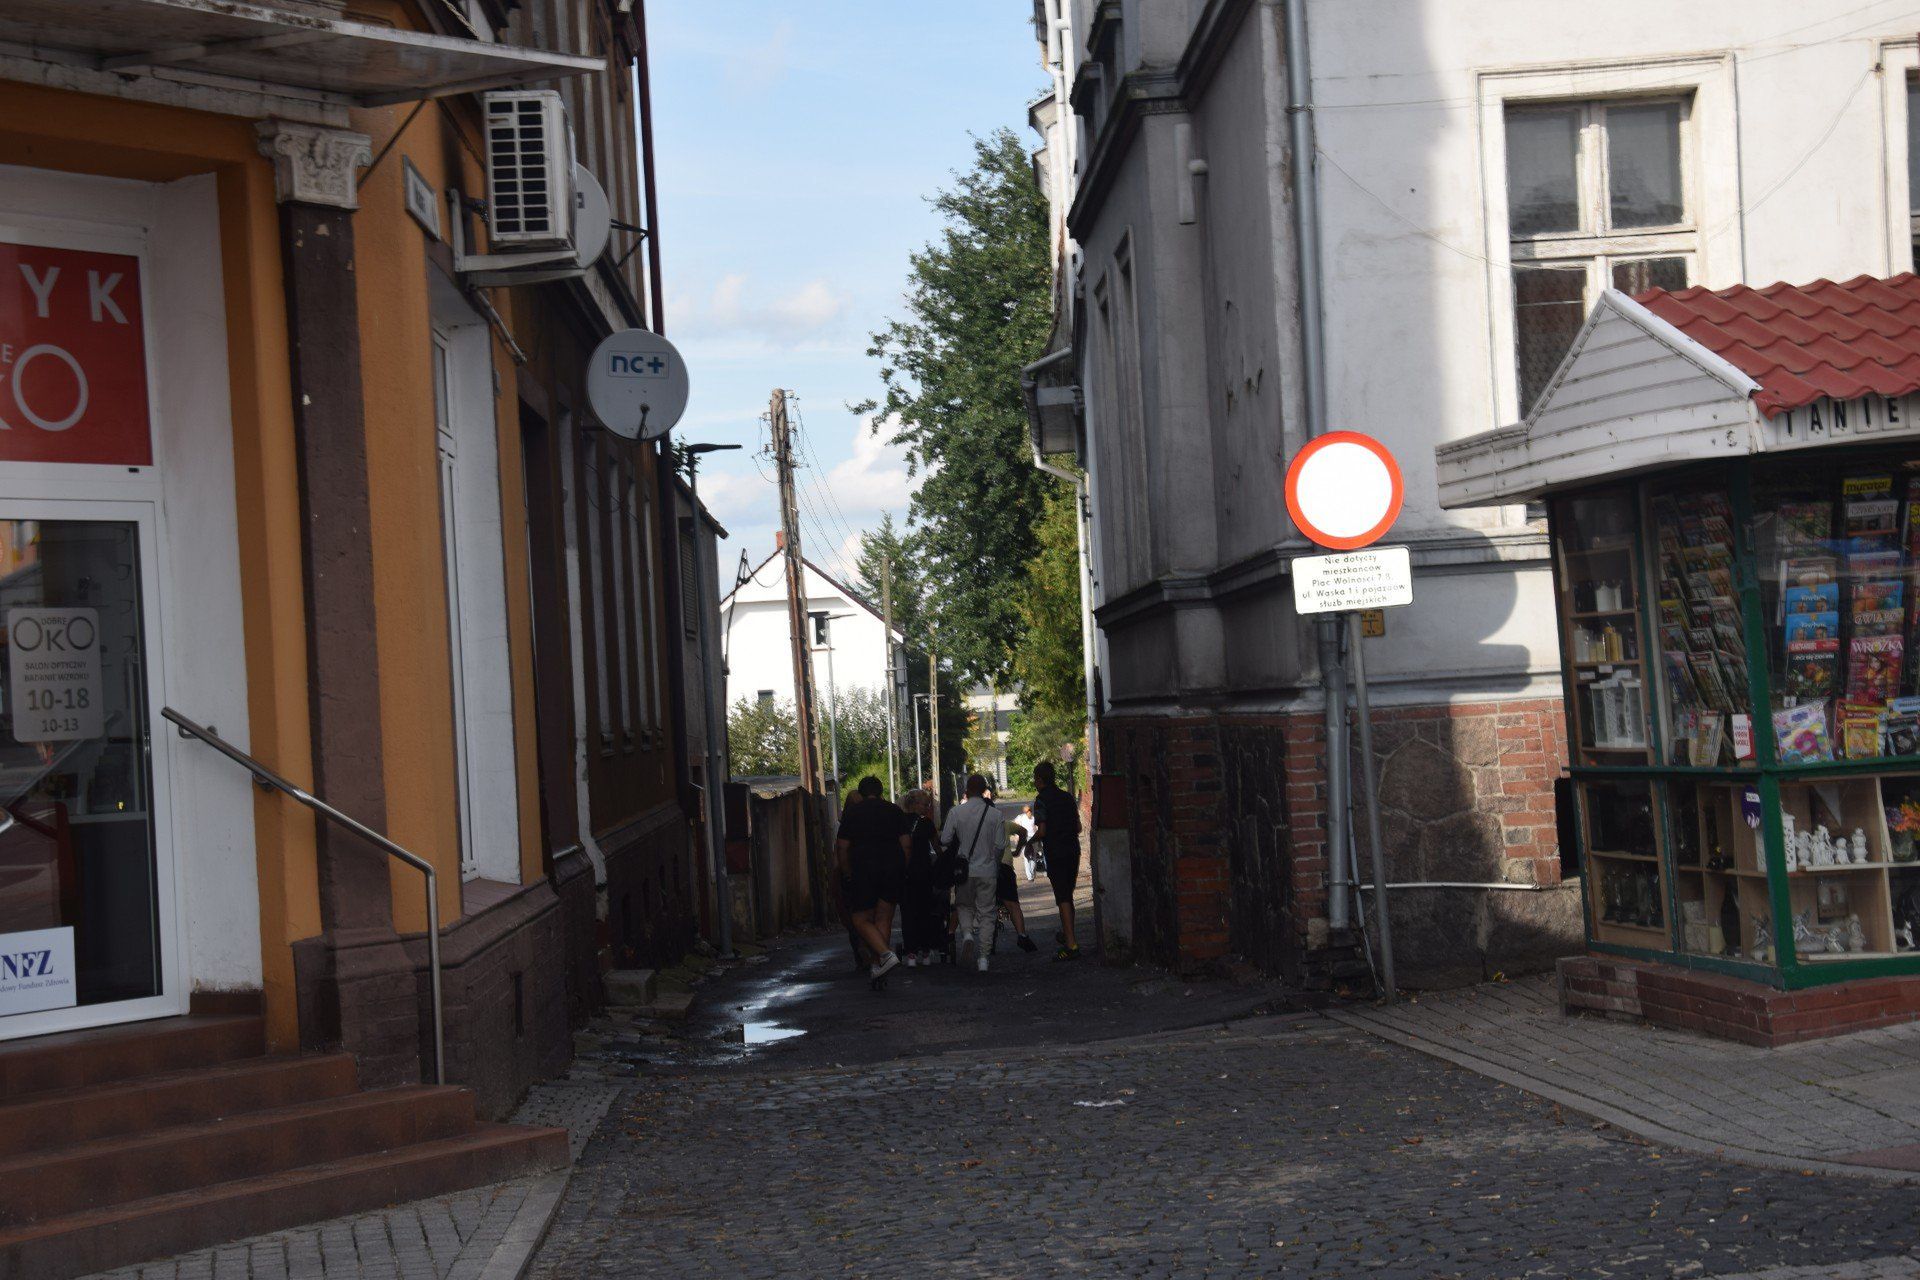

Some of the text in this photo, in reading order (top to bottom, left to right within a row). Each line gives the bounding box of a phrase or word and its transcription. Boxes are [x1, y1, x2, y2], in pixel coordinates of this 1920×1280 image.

[611, 354, 665, 374] nc+
[1784, 397, 1899, 435] TANIE
[1324, 555, 1377, 565] Nie dotyczy
[1312, 579, 1331, 587] Plac
[13, 616, 95, 652] OKO
[25, 660, 87, 671] SALON OPTYCZNY
[24, 672, 90, 682] BADANIE WZROKU
[27, 687, 90, 712] 10-18
[41, 717, 80, 734] 10-13
[1, 950, 53, 980] NFZ
[18, 981, 43, 990] Fundusz
[45, 978, 69, 987] Zdrowia
